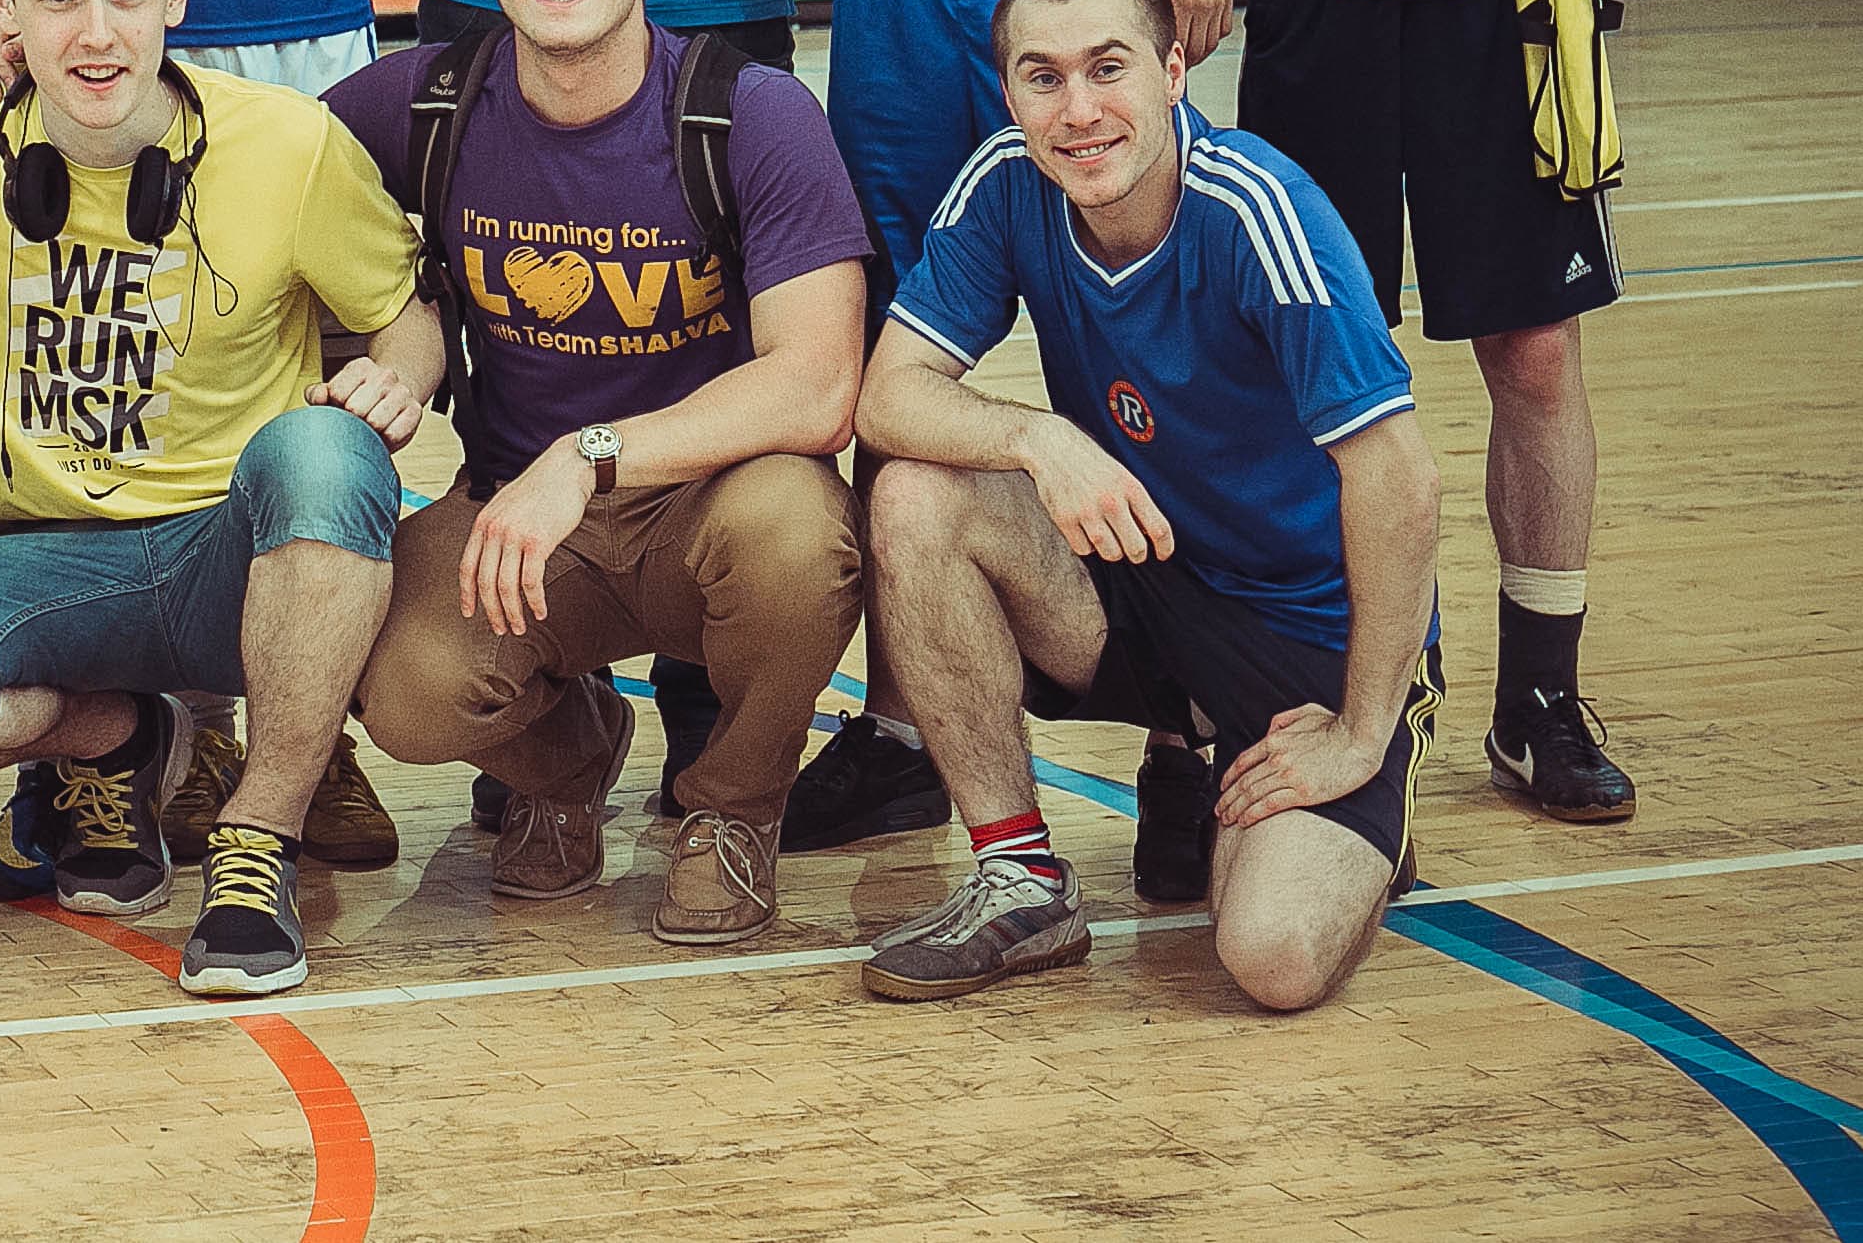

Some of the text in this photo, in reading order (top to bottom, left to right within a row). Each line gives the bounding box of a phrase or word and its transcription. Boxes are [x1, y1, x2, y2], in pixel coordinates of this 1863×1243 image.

[463, 208, 686, 254] I'm running for...
[47, 239, 153, 325] WE
[24, 305, 158, 392] RUN
[19, 367, 150, 455] MSK
[1120, 393, 1145, 429] R
